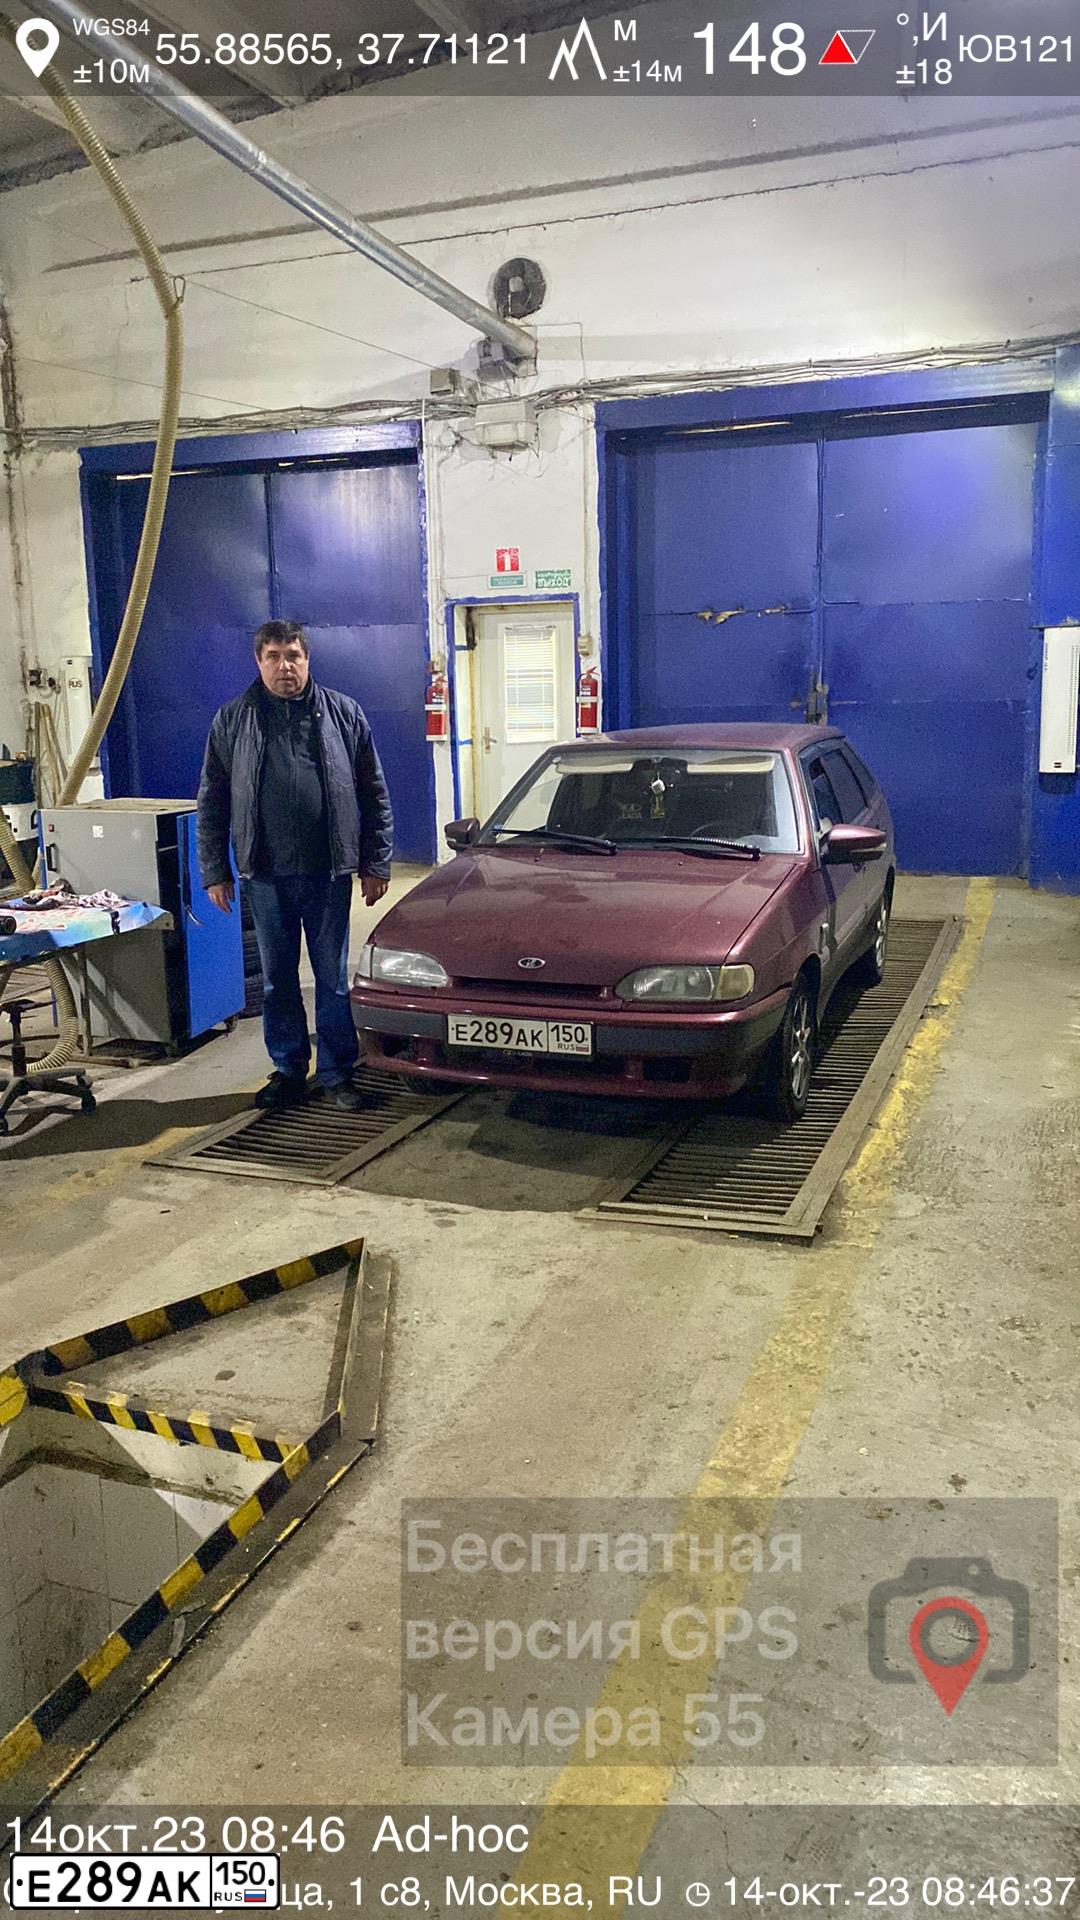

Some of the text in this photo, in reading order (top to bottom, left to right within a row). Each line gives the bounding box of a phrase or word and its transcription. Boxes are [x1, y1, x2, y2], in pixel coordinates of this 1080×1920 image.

[455, 1020, 586, 1048] Е289АК 150
[557, 1043, 576, 1051] RUS
